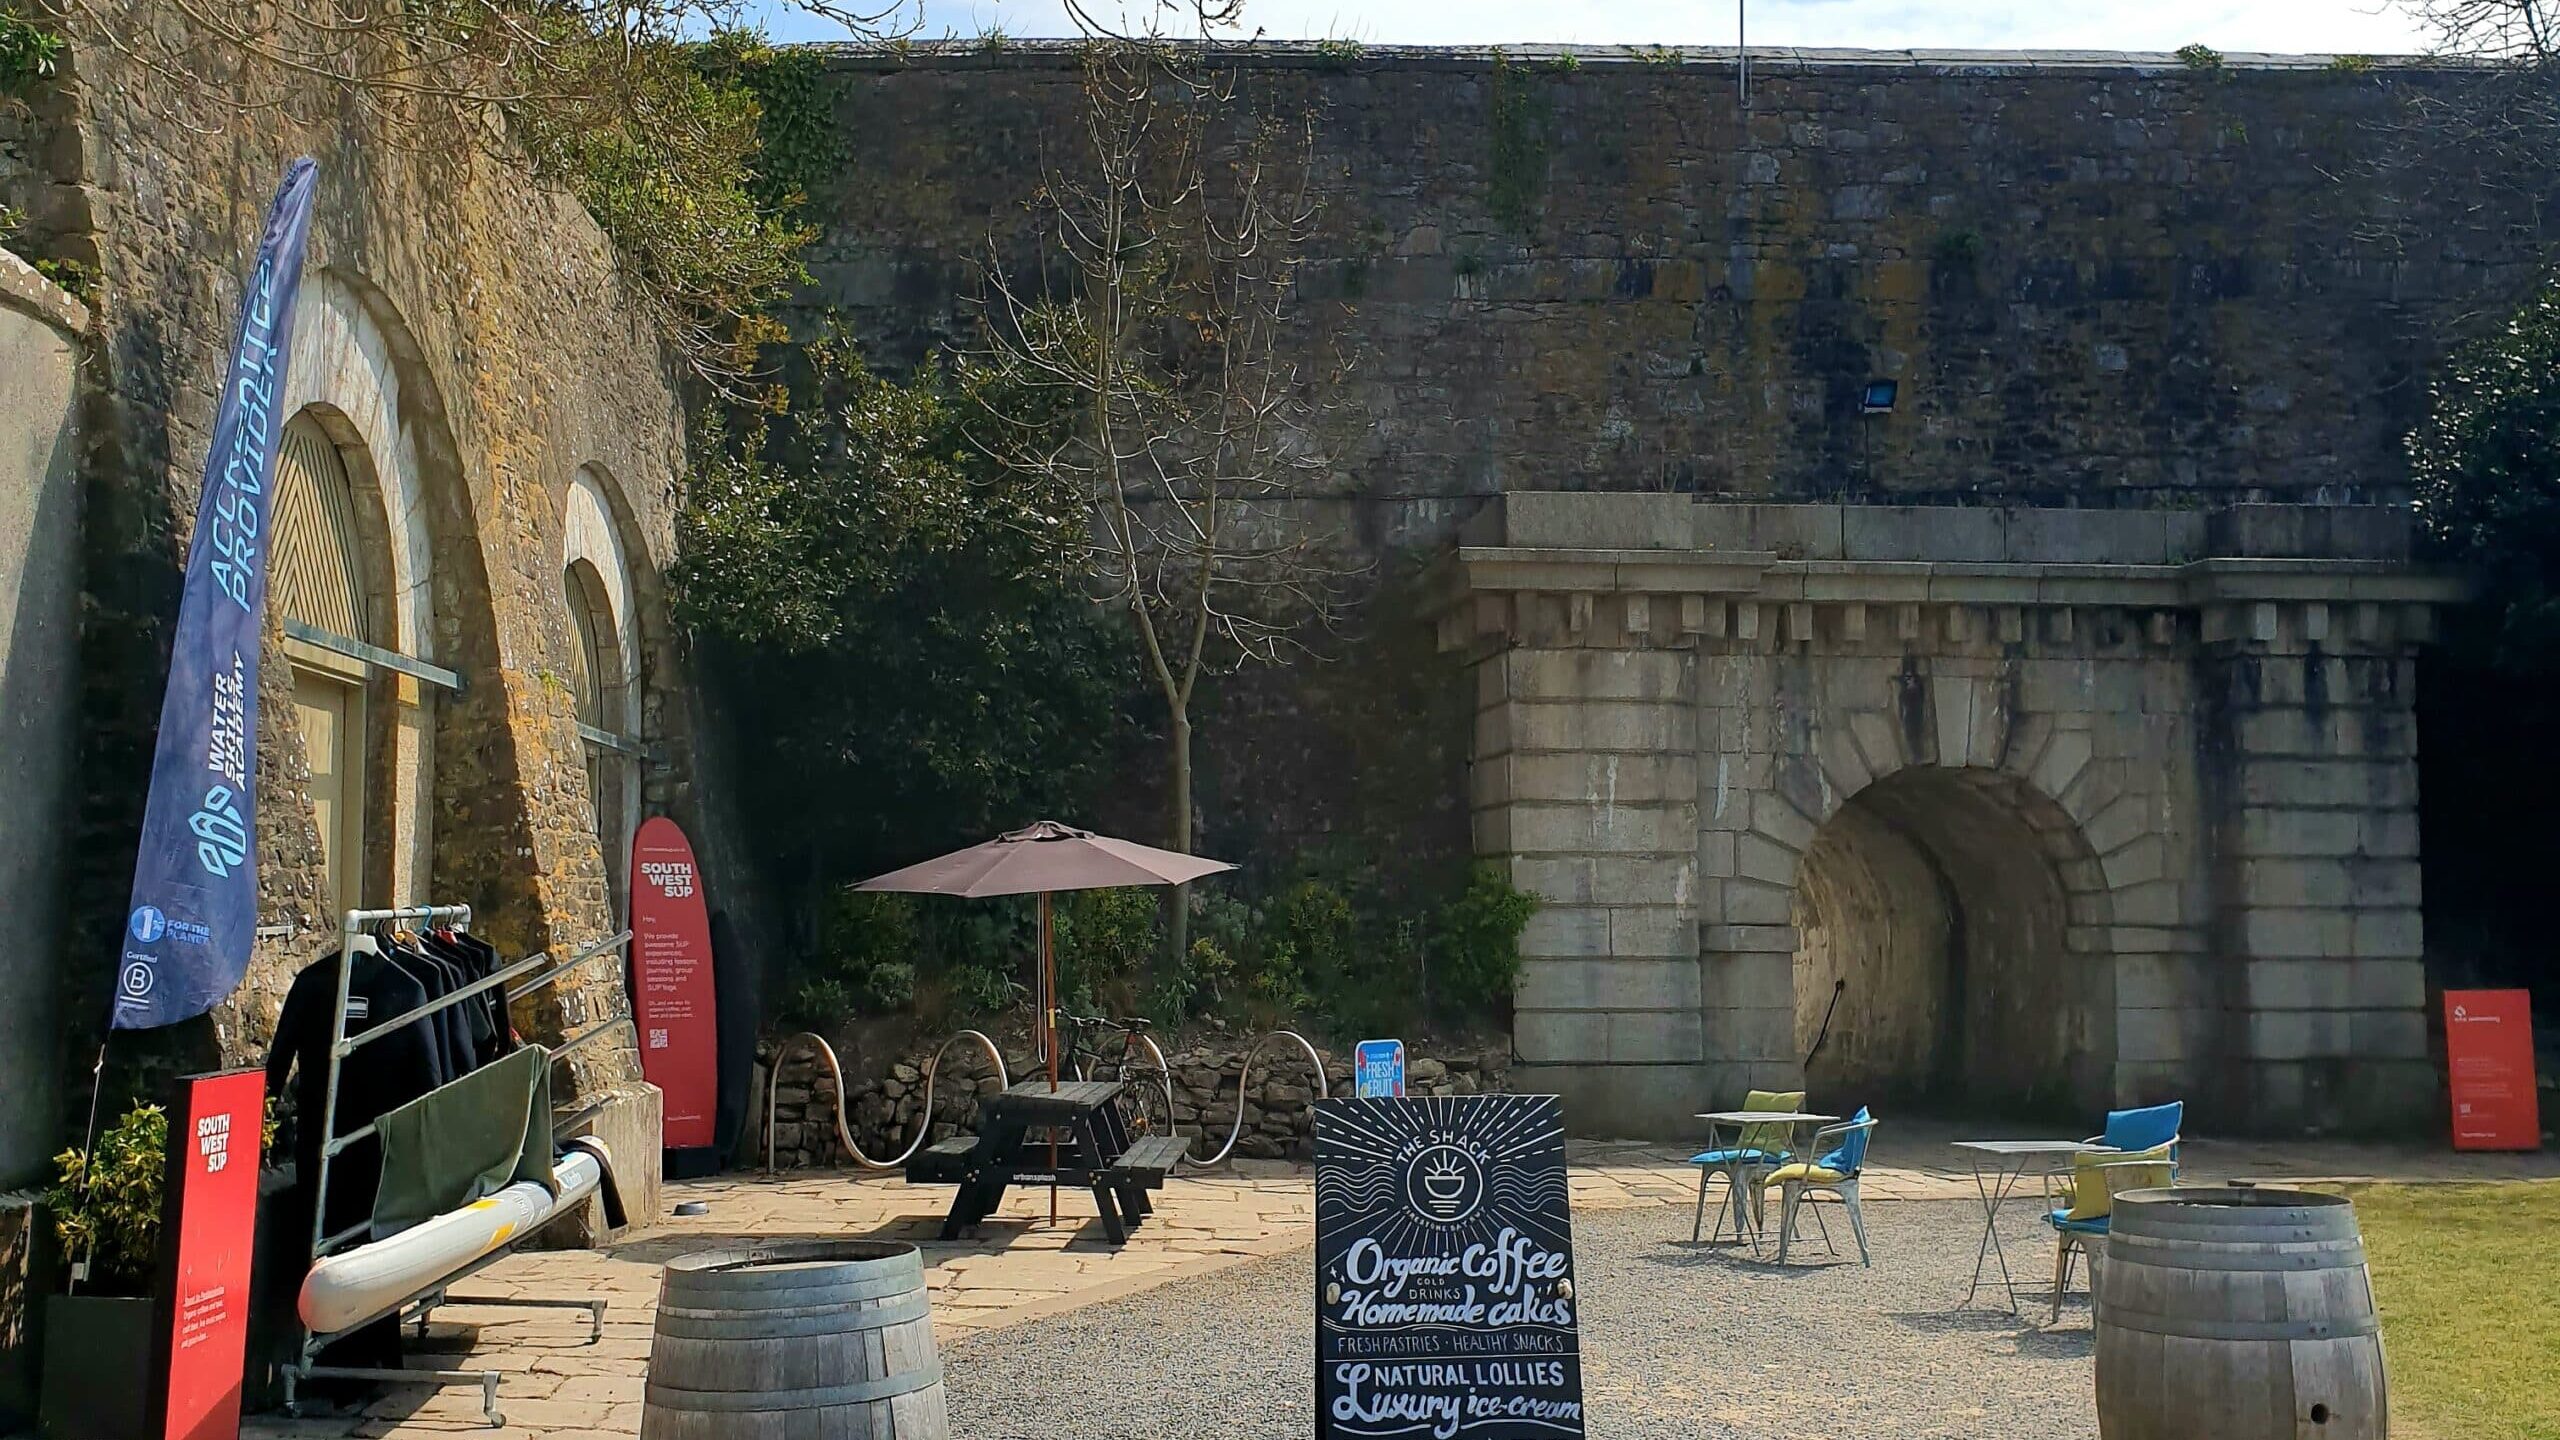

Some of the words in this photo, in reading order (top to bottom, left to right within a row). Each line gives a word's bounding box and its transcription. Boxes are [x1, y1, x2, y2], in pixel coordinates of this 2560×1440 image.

[208, 672, 228, 772] WATER
[225, 675, 236, 782] SKILLS
[235, 649, 246, 793] ACADEMY
[641, 862, 692, 874] SOUTH
[648, 874, 693, 886] WEST
[664, 885, 694, 898] SUP
[167, 920, 189, 932] FOR
[191, 924, 210, 936] THE
[1366, 1061, 1395, 1079] FRESH
[1368, 1079, 1393, 1097] FRUIT
[197, 1113, 231, 1137] SOUTH
[200, 1132, 229, 1156] WEST
[1396, 1135, 1424, 1163] THE
[1429, 1129, 1491, 1164] SHACK
[207, 1151, 228, 1173] SUP
[1346, 1238, 1461, 1298] Organic
[1462, 1227, 1568, 1296] Coffee
[1416, 1277, 1446, 1286] COLD
[1340, 1285, 1485, 1327] Homemade
[1488, 1283, 1571, 1327] cakes
[1409, 1287, 1461, 1301] DRINKS
[1453, 1333, 1508, 1352] HEALTHY
[1513, 1333, 1564, 1353] SNACKS
[1374, 1363, 1470, 1387] NATURAL
[1475, 1361, 1565, 1387] LOLLIES
[1332, 1362, 1461, 1439] Luxury
[1467, 1387, 1581, 1420] ice-cream
